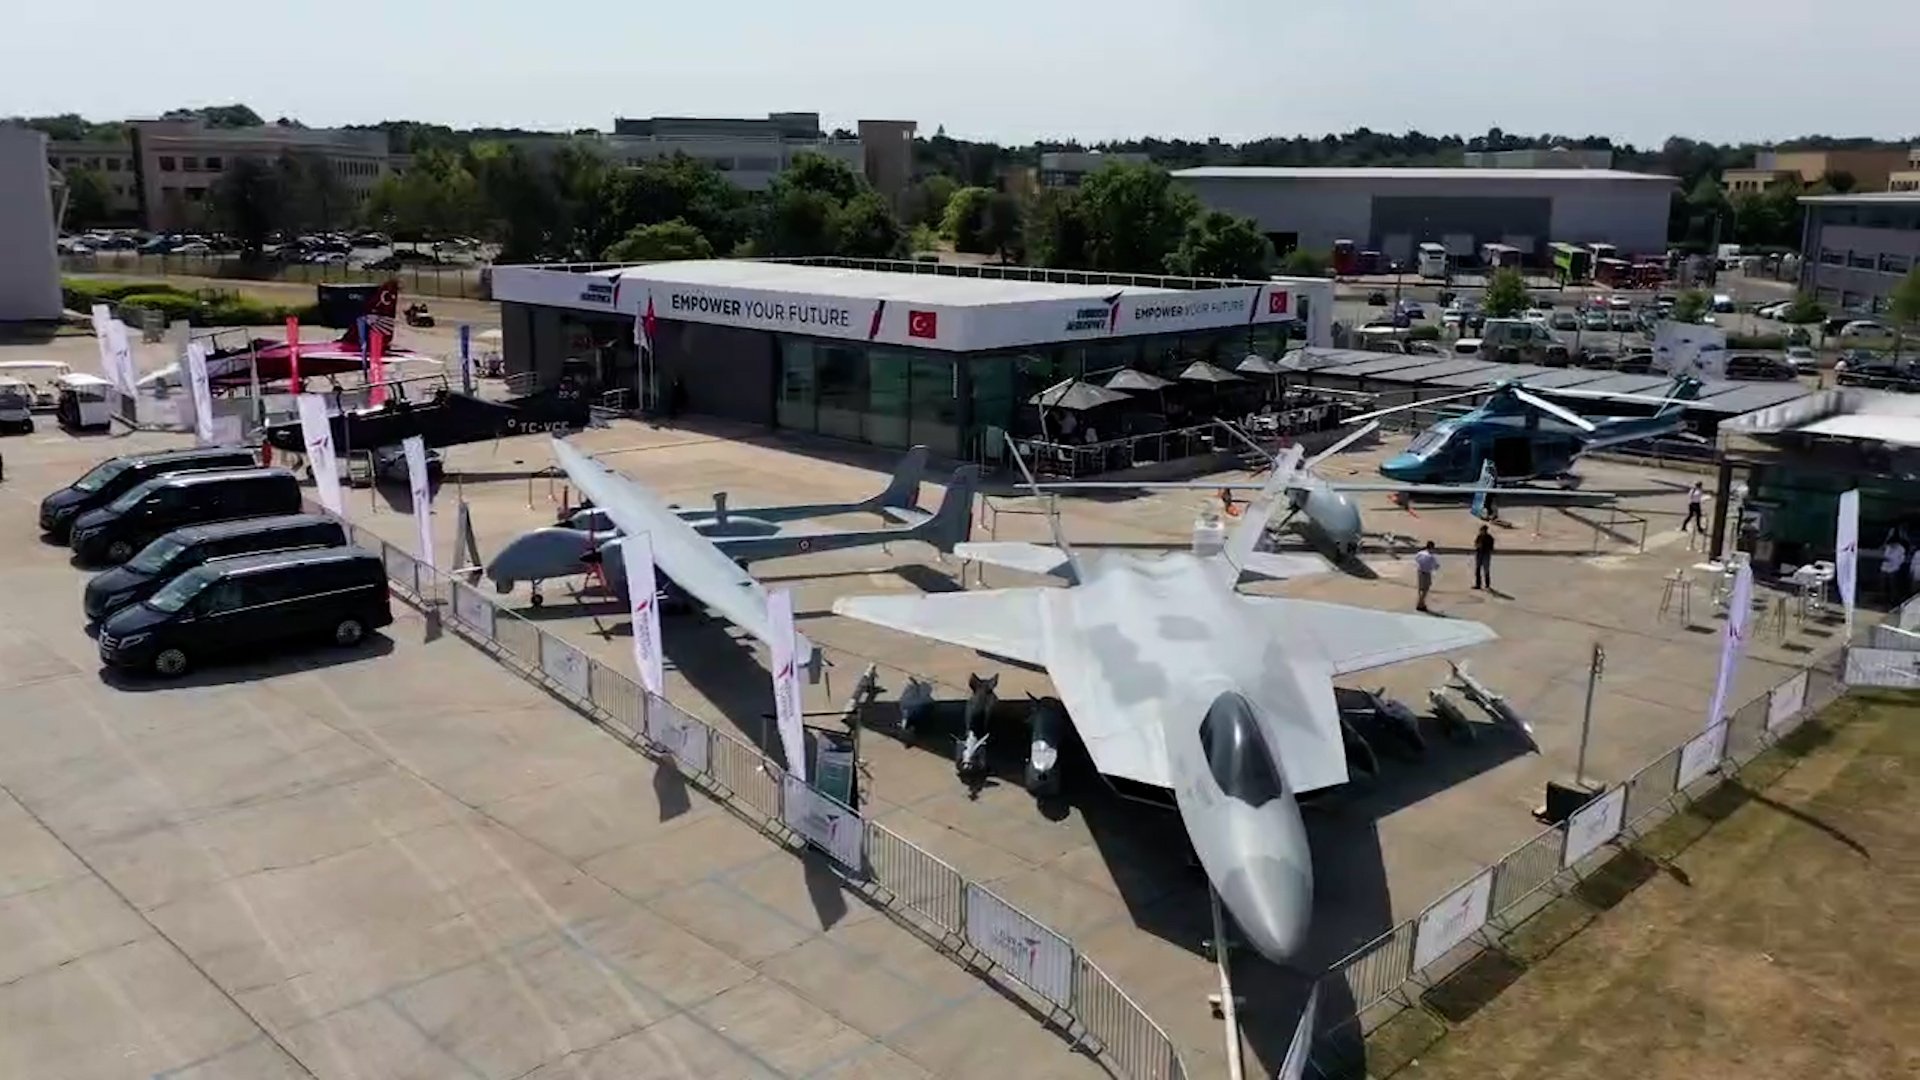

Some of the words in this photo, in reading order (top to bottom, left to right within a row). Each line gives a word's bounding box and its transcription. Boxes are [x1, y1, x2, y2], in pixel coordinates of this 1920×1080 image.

[671, 294, 742, 317] EMPOWER
[745, 301, 785, 320] YOUR
[789, 305, 849, 327] FUTURE
[1135, 306, 1184, 320] EMPOWER
